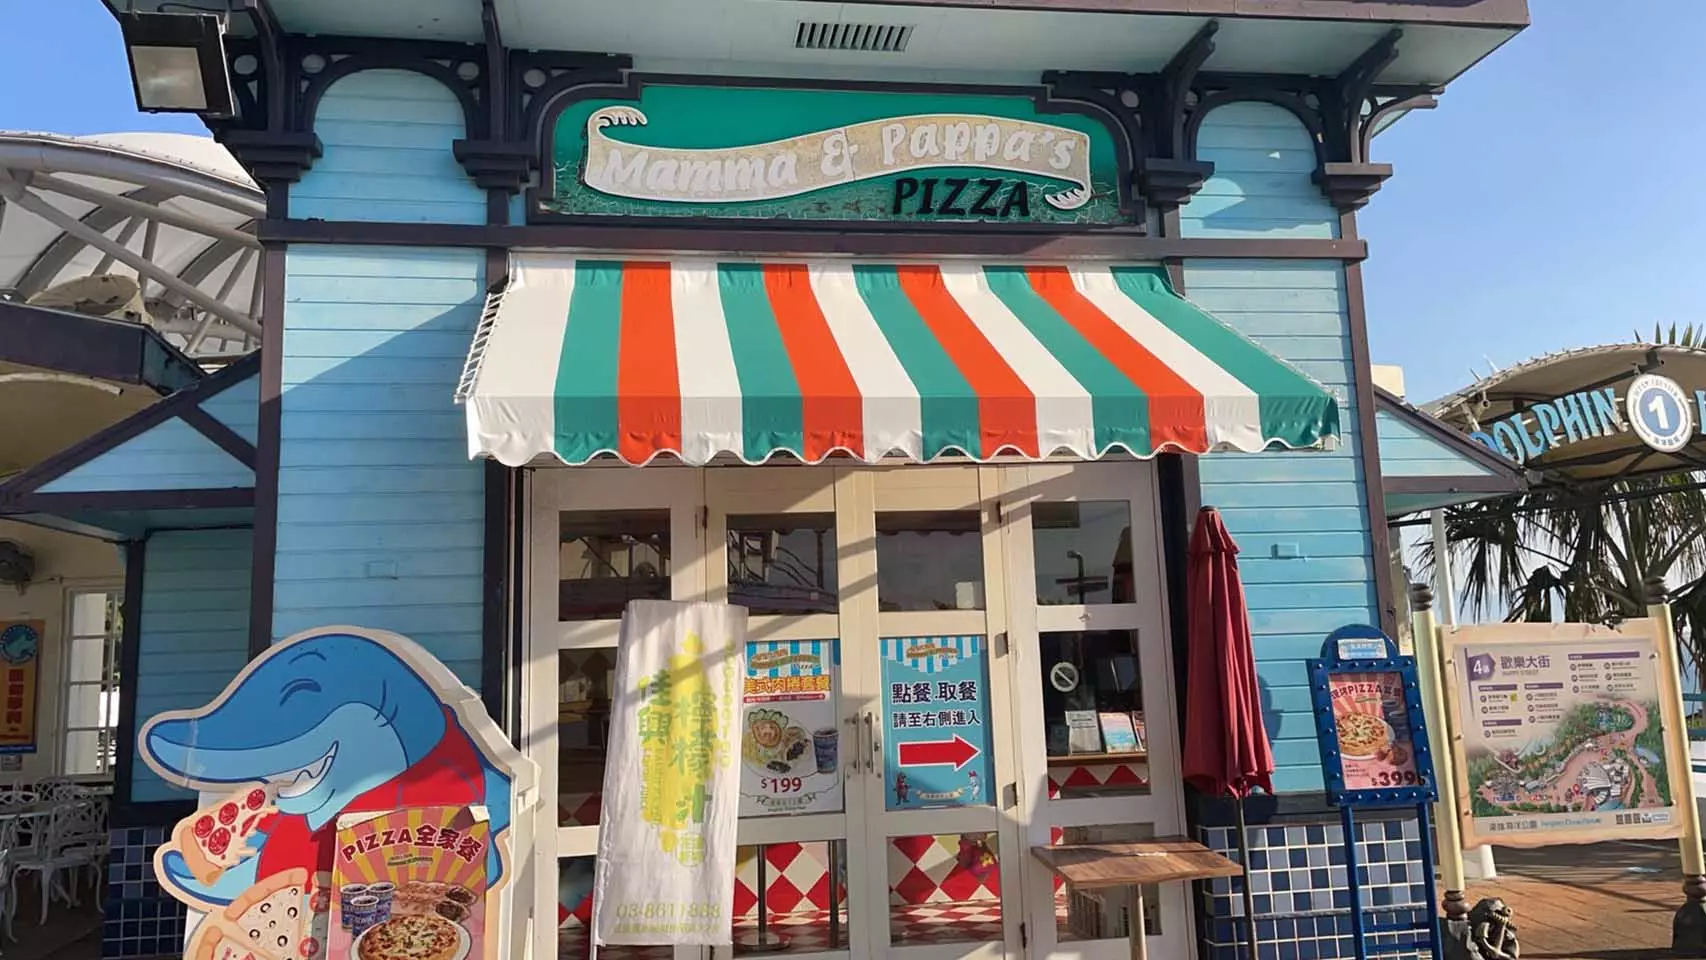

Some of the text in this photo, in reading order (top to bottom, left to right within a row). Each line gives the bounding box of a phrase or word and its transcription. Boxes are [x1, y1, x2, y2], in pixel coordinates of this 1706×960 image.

[600, 115, 1076, 198] Mamma & Pappa's
[893, 177, 1030, 218] PIZZA
[1648, 395, 1669, 430] 1
[1500, 655, 1551, 669] 歡樂大街
[893, 709, 981, 729] 請至右側進入
[760, 776, 802, 794] $199
[341, 824, 483, 863] PIZZA全家餐
